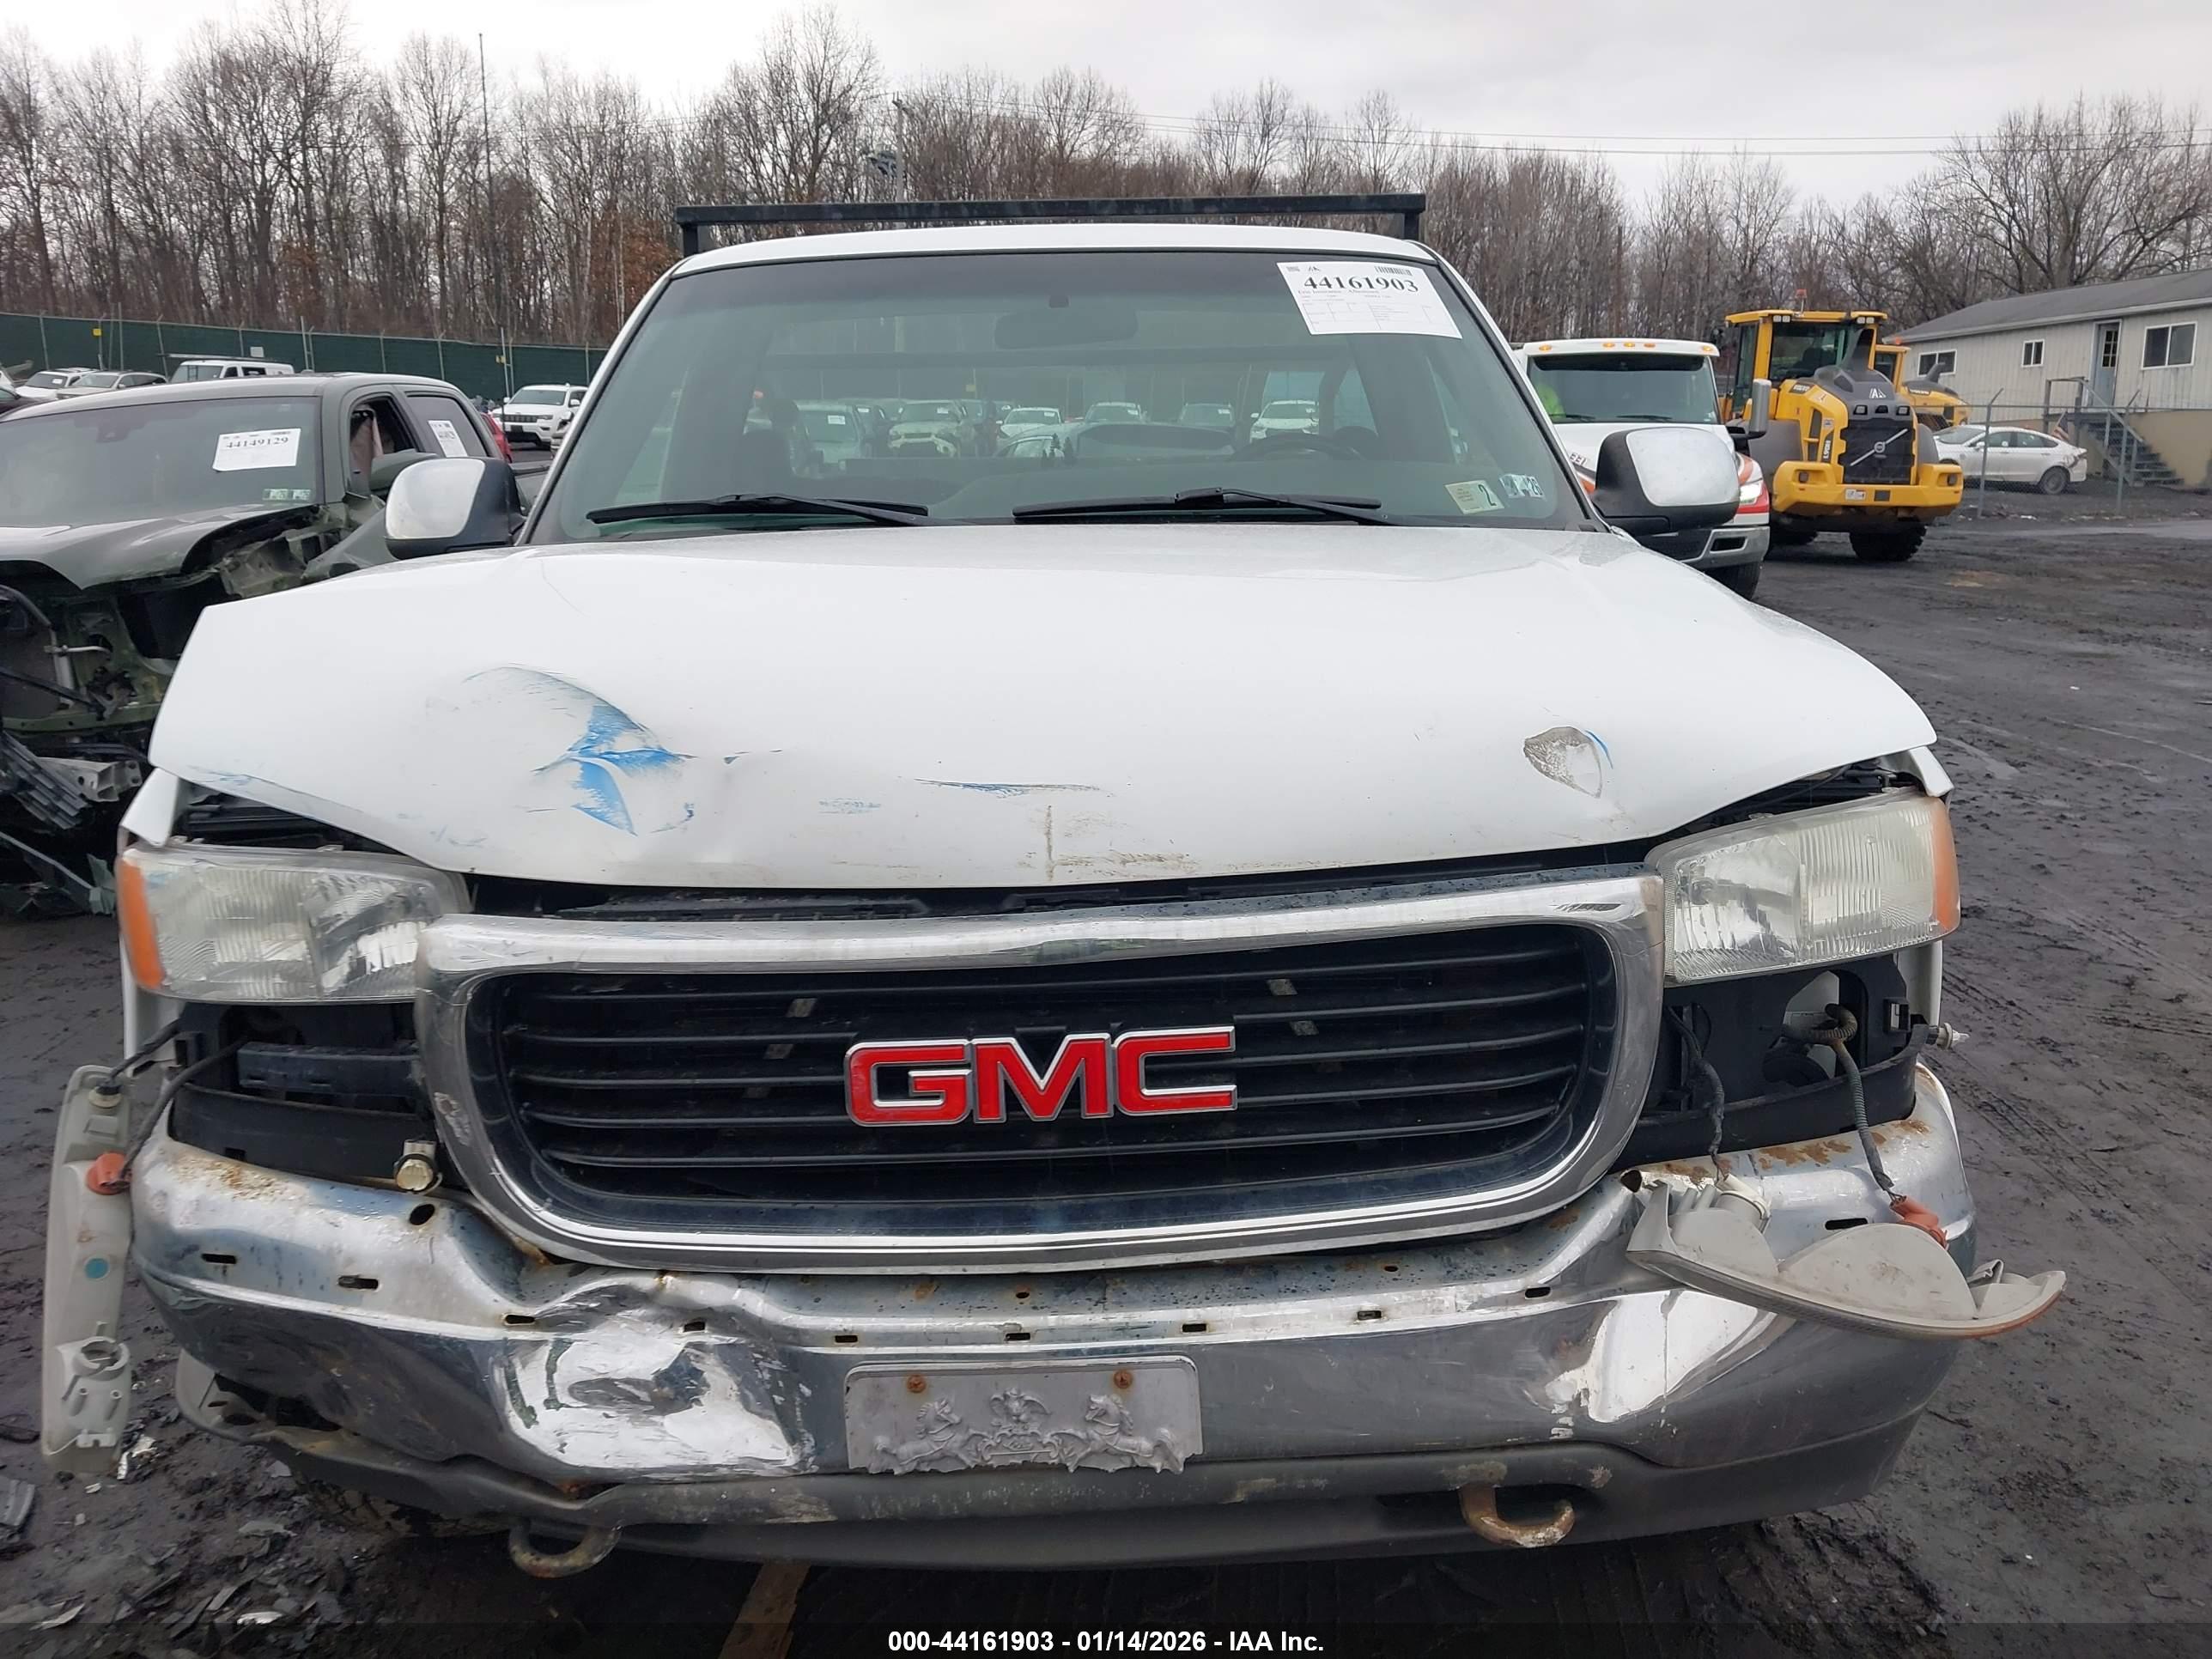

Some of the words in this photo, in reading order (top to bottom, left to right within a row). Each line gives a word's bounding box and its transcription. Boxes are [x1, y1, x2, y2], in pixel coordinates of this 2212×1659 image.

[1304, 276, 1419, 293] 44161903
[226, 437, 289, 448] 44149129
[845, 1025, 1237, 1127] GMC
